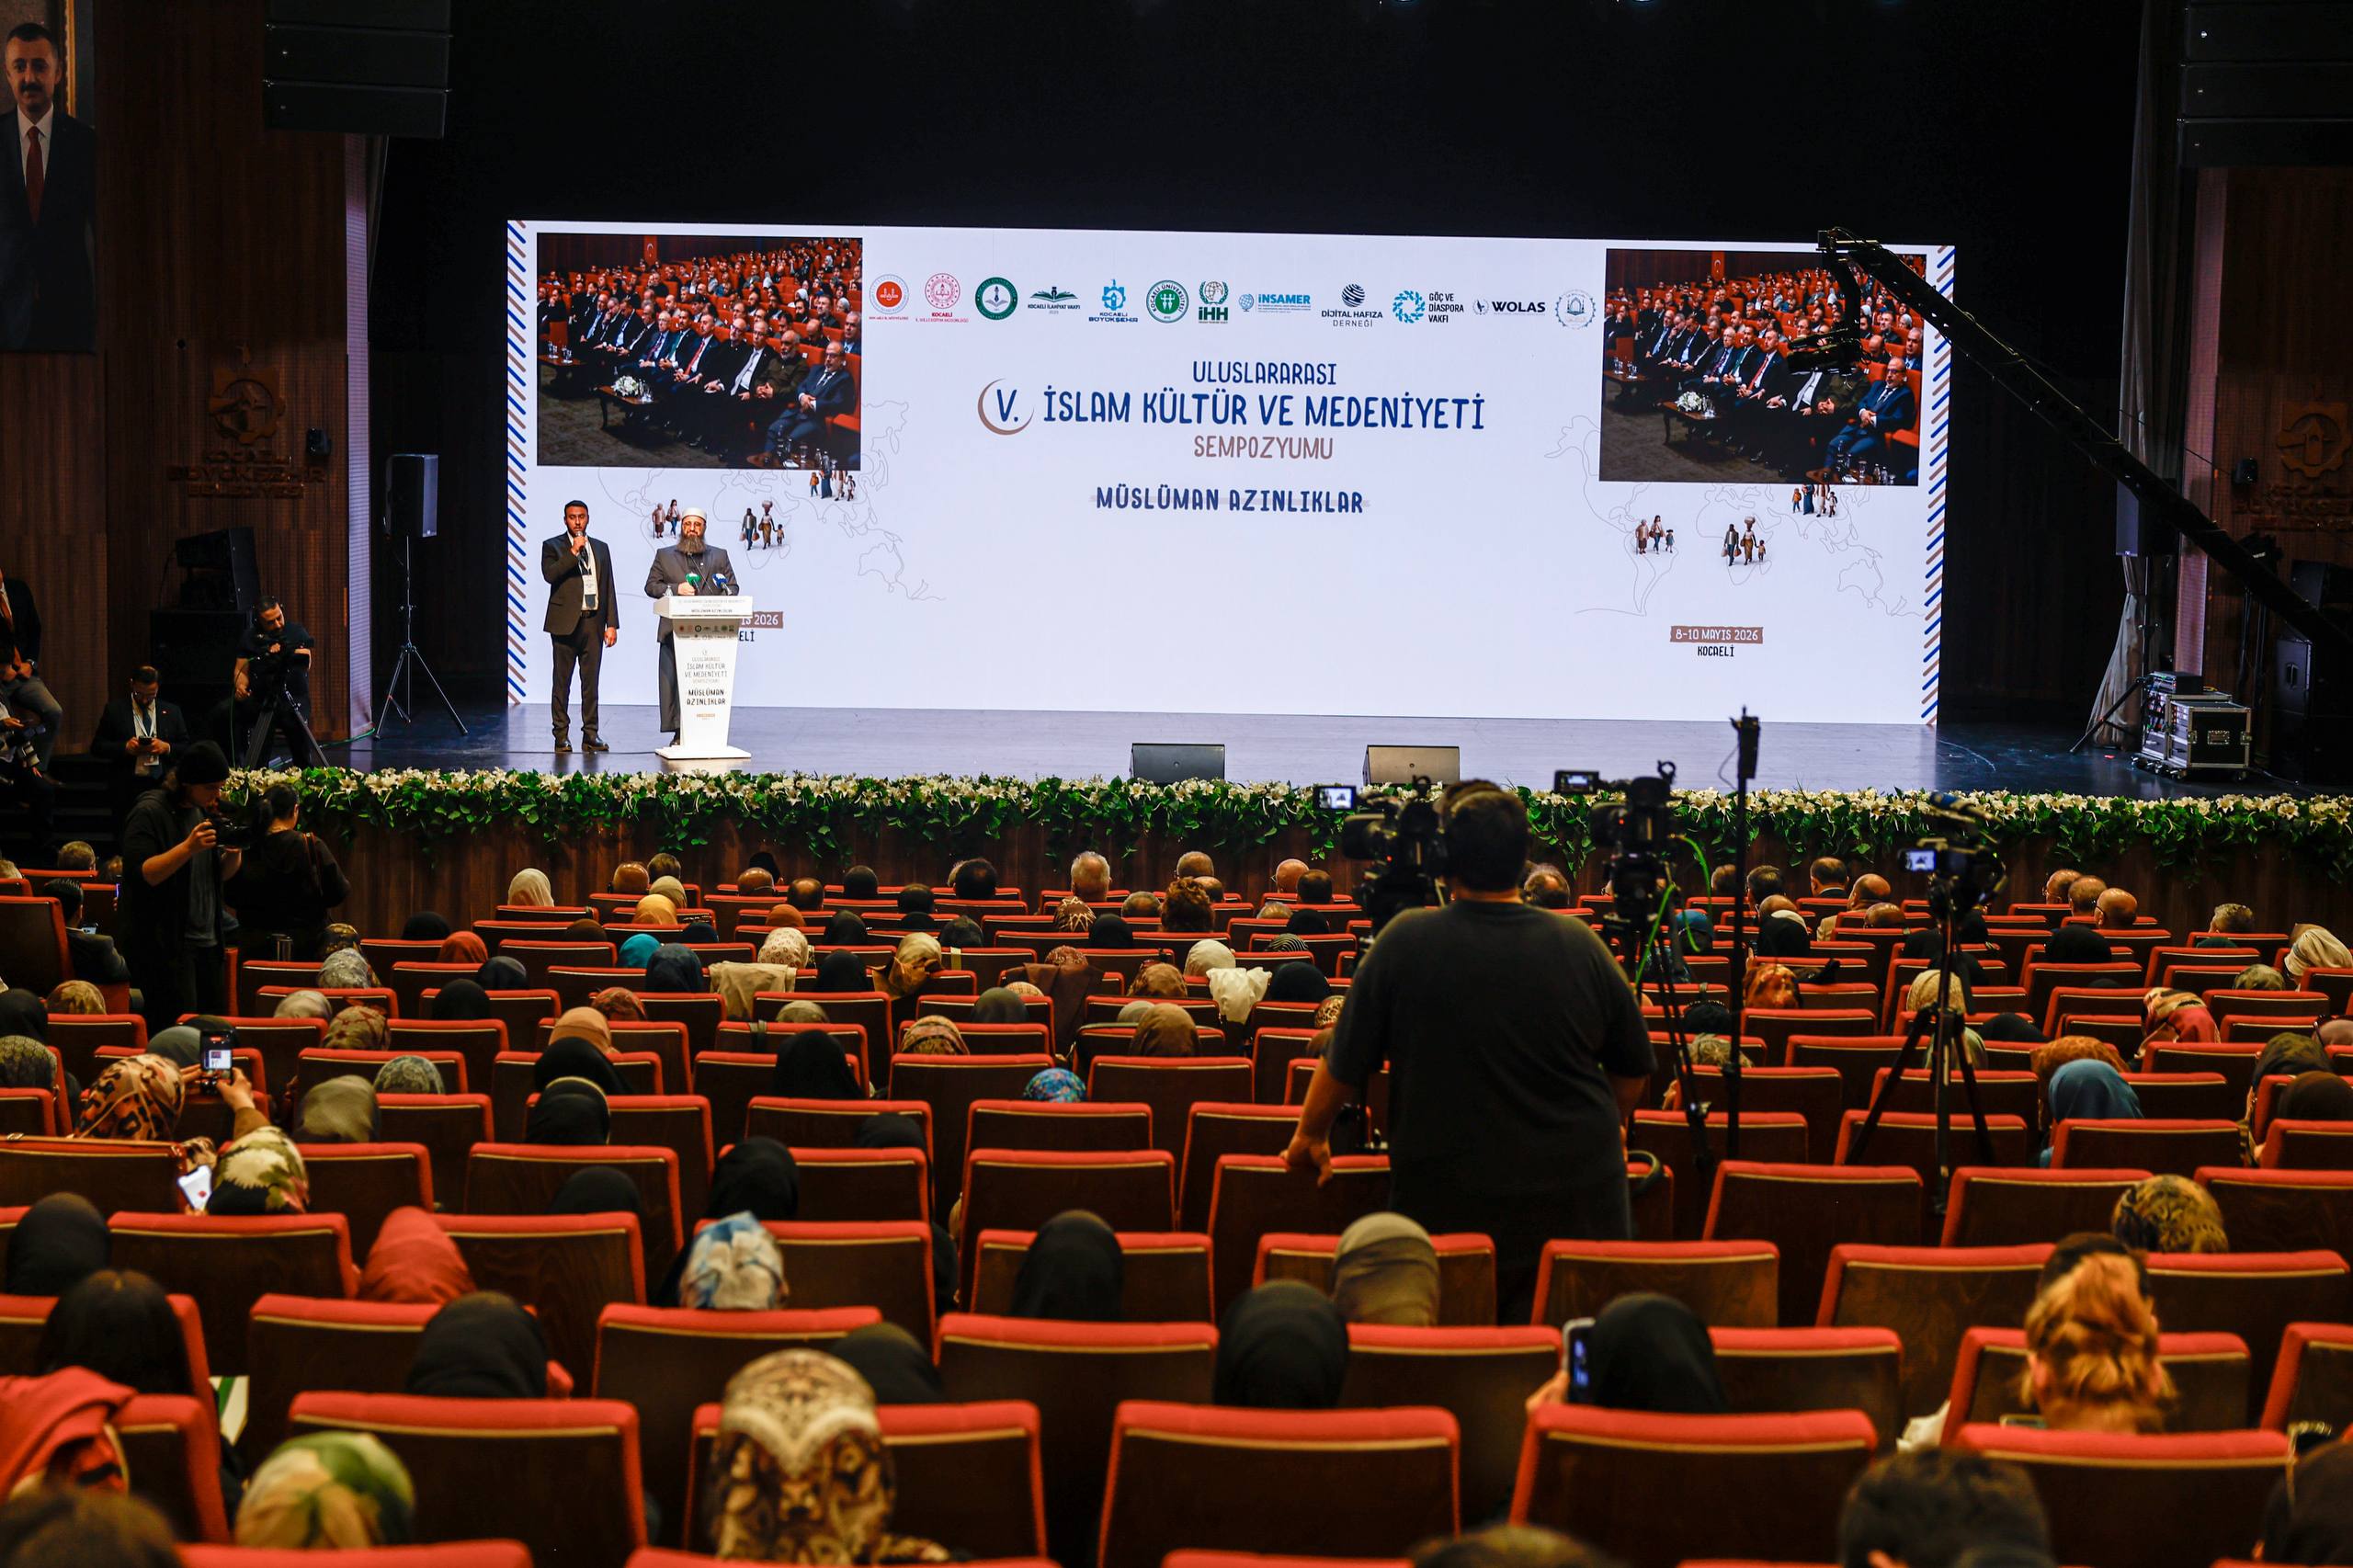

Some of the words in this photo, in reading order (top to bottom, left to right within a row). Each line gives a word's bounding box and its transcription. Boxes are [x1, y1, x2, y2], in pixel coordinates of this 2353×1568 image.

[1428, 291, 1444, 303] GÖÇ
[1445, 292, 1454, 302] VE
[1428, 302, 1464, 312] DİASPORA
[1491, 301, 1546, 313] WOLAS
[1353, 311, 1383, 319] HAFIZA
[1428, 314, 1449, 324] VAKFI
[1333, 319, 1373, 328] DERNEĞİ
[1192, 360, 1338, 386] ULUSLARARASI
[1043, 385, 1131, 424] İSLAM
[1142, 388, 1247, 426] KÜLTÜR
[1258, 394, 1294, 427] VE
[1304, 391, 1485, 431] MEDENİYETİ
[1193, 435, 1335, 460] SEMPOZYUMU
[1096, 483, 1220, 513] MÜSLÜMAN
[1228, 488, 1364, 514] AZINLIKLAR
[754, 615, 779, 626] 2026
[739, 630, 756, 642] ELİ
[1675, 628, 1699, 641] 8-10
[1701, 629, 1732, 642] MAYIS
[1734, 630, 1759, 642] 2026
[1697, 644, 1735, 658] KOCAELİ
